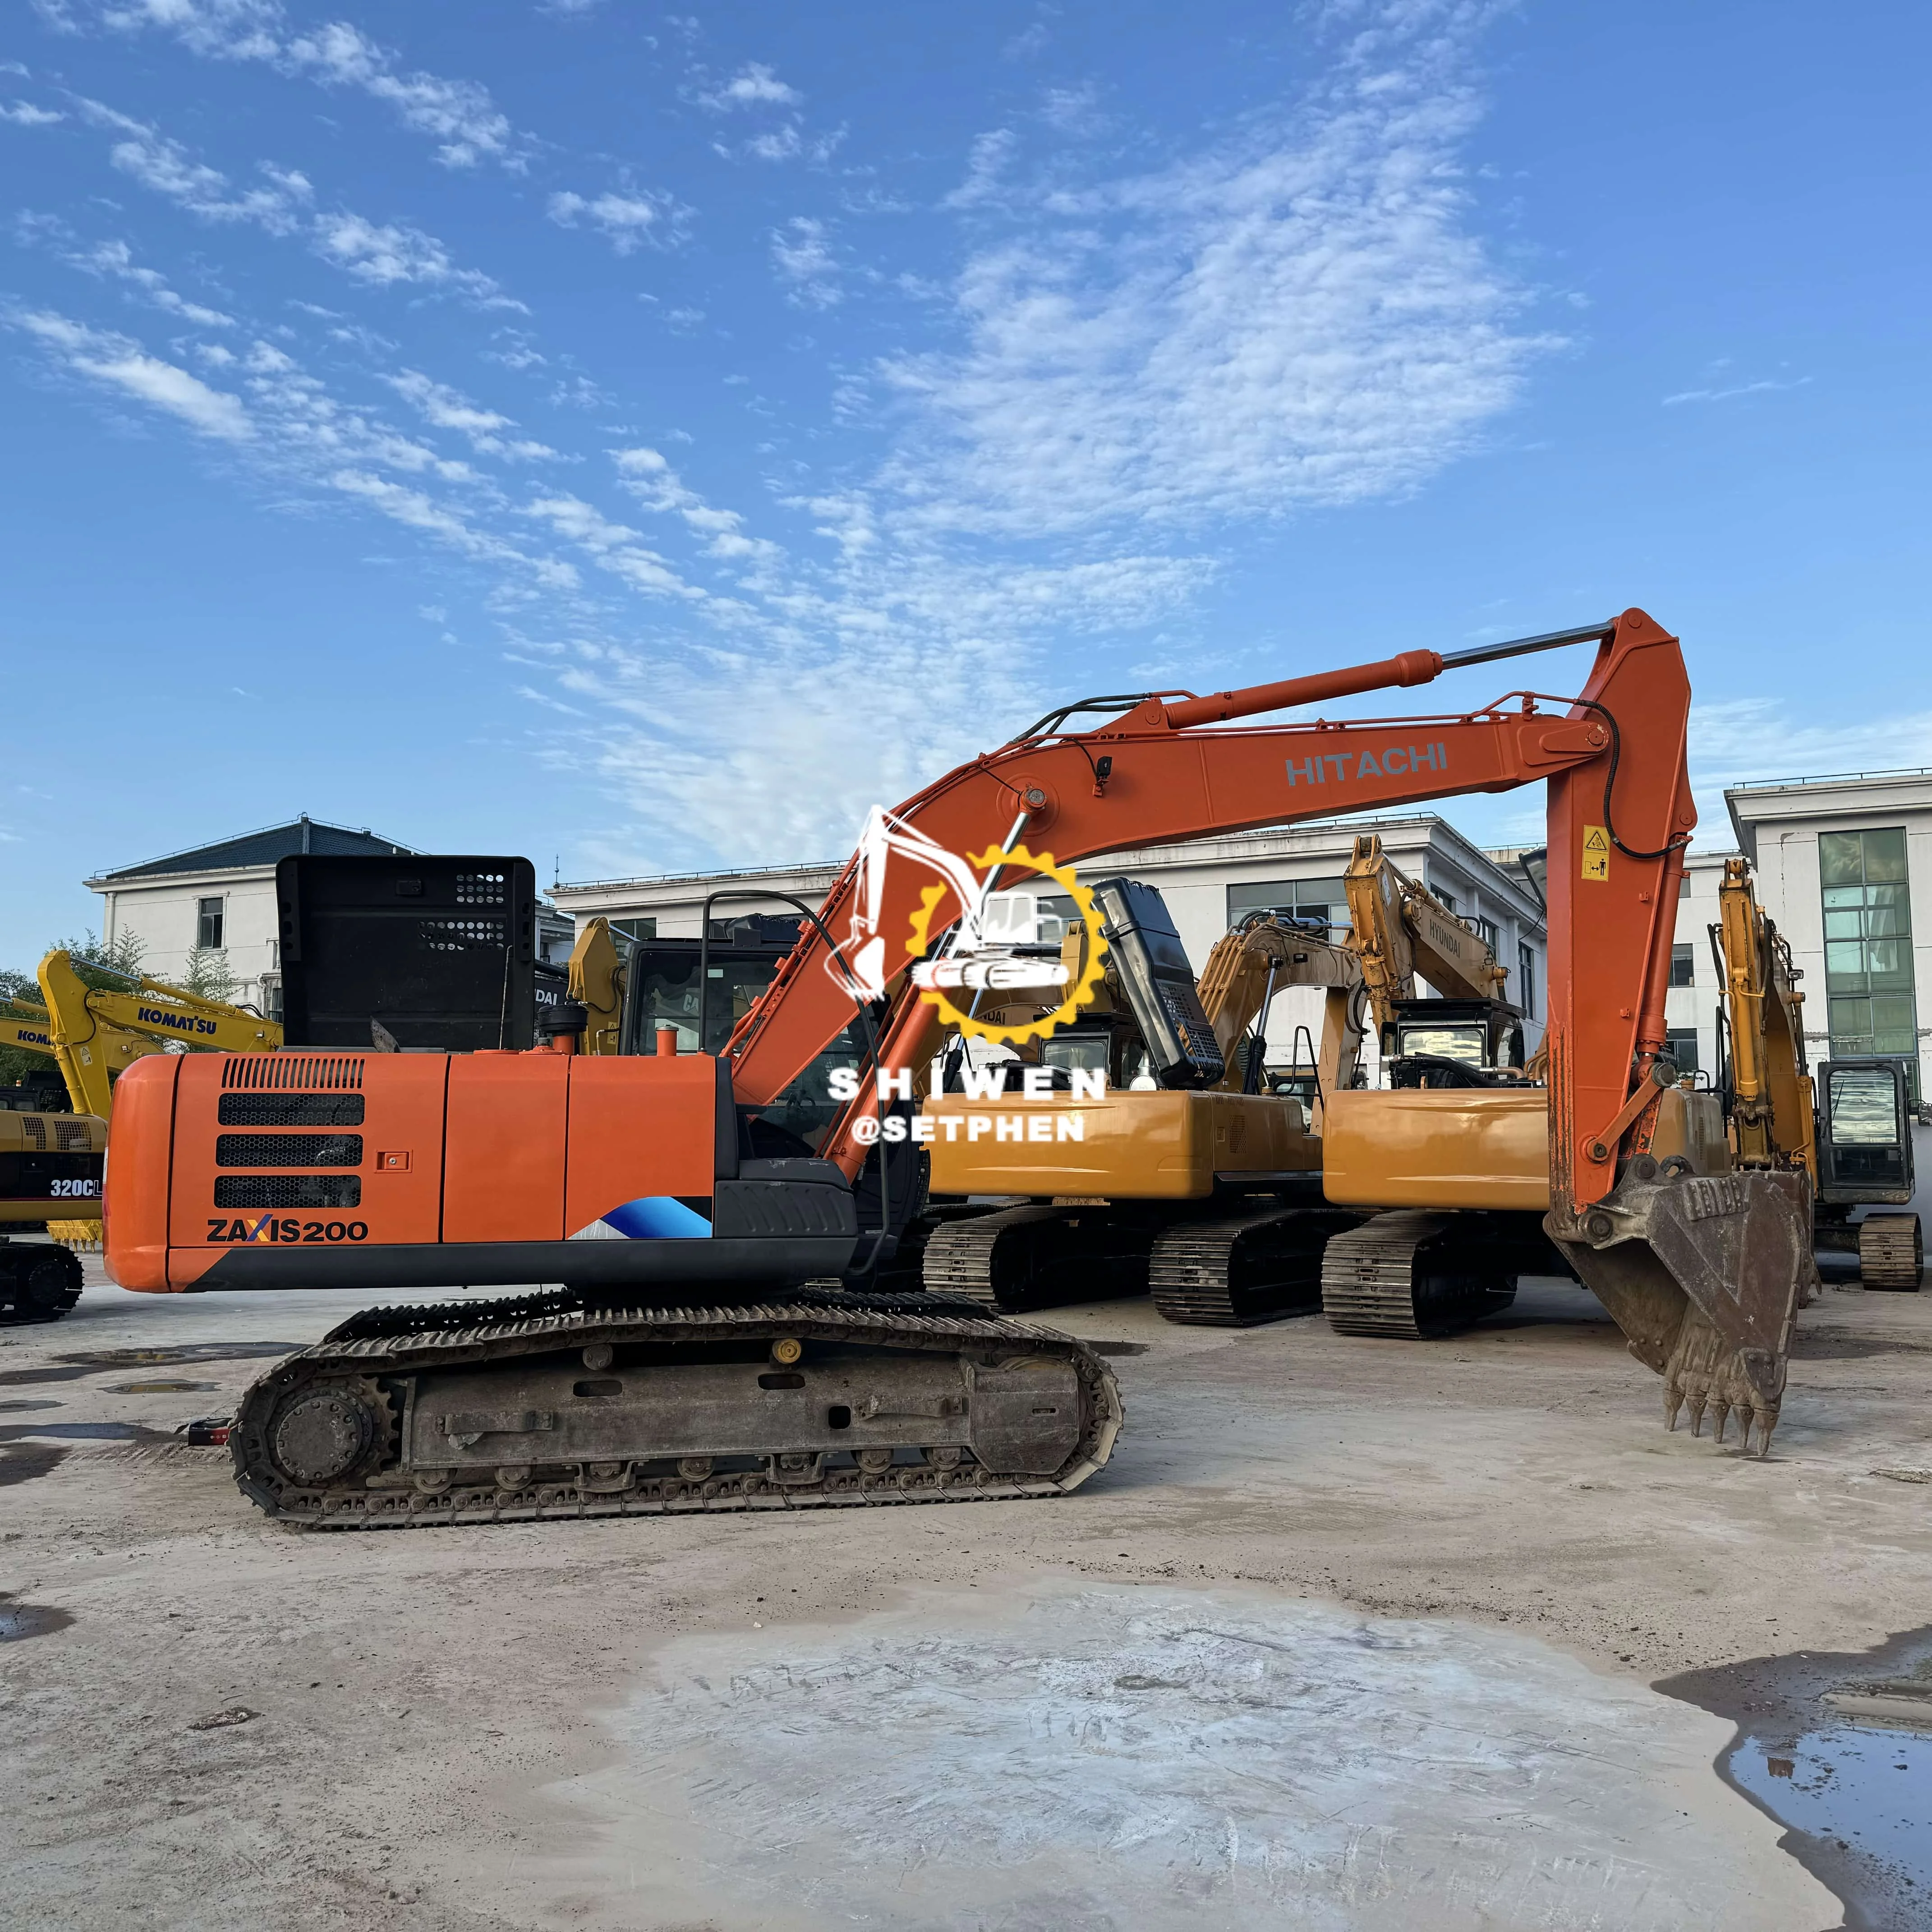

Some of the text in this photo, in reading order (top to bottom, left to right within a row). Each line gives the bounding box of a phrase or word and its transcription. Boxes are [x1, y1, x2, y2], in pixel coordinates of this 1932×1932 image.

[1285, 743, 1447, 787] HITACHI
[1430, 918, 1460, 959] HYUNDAI
[535, 989, 557, 1006] DAI
[683, 994, 699, 1012] CA
[138, 1007, 217, 1035] KOMATSU
